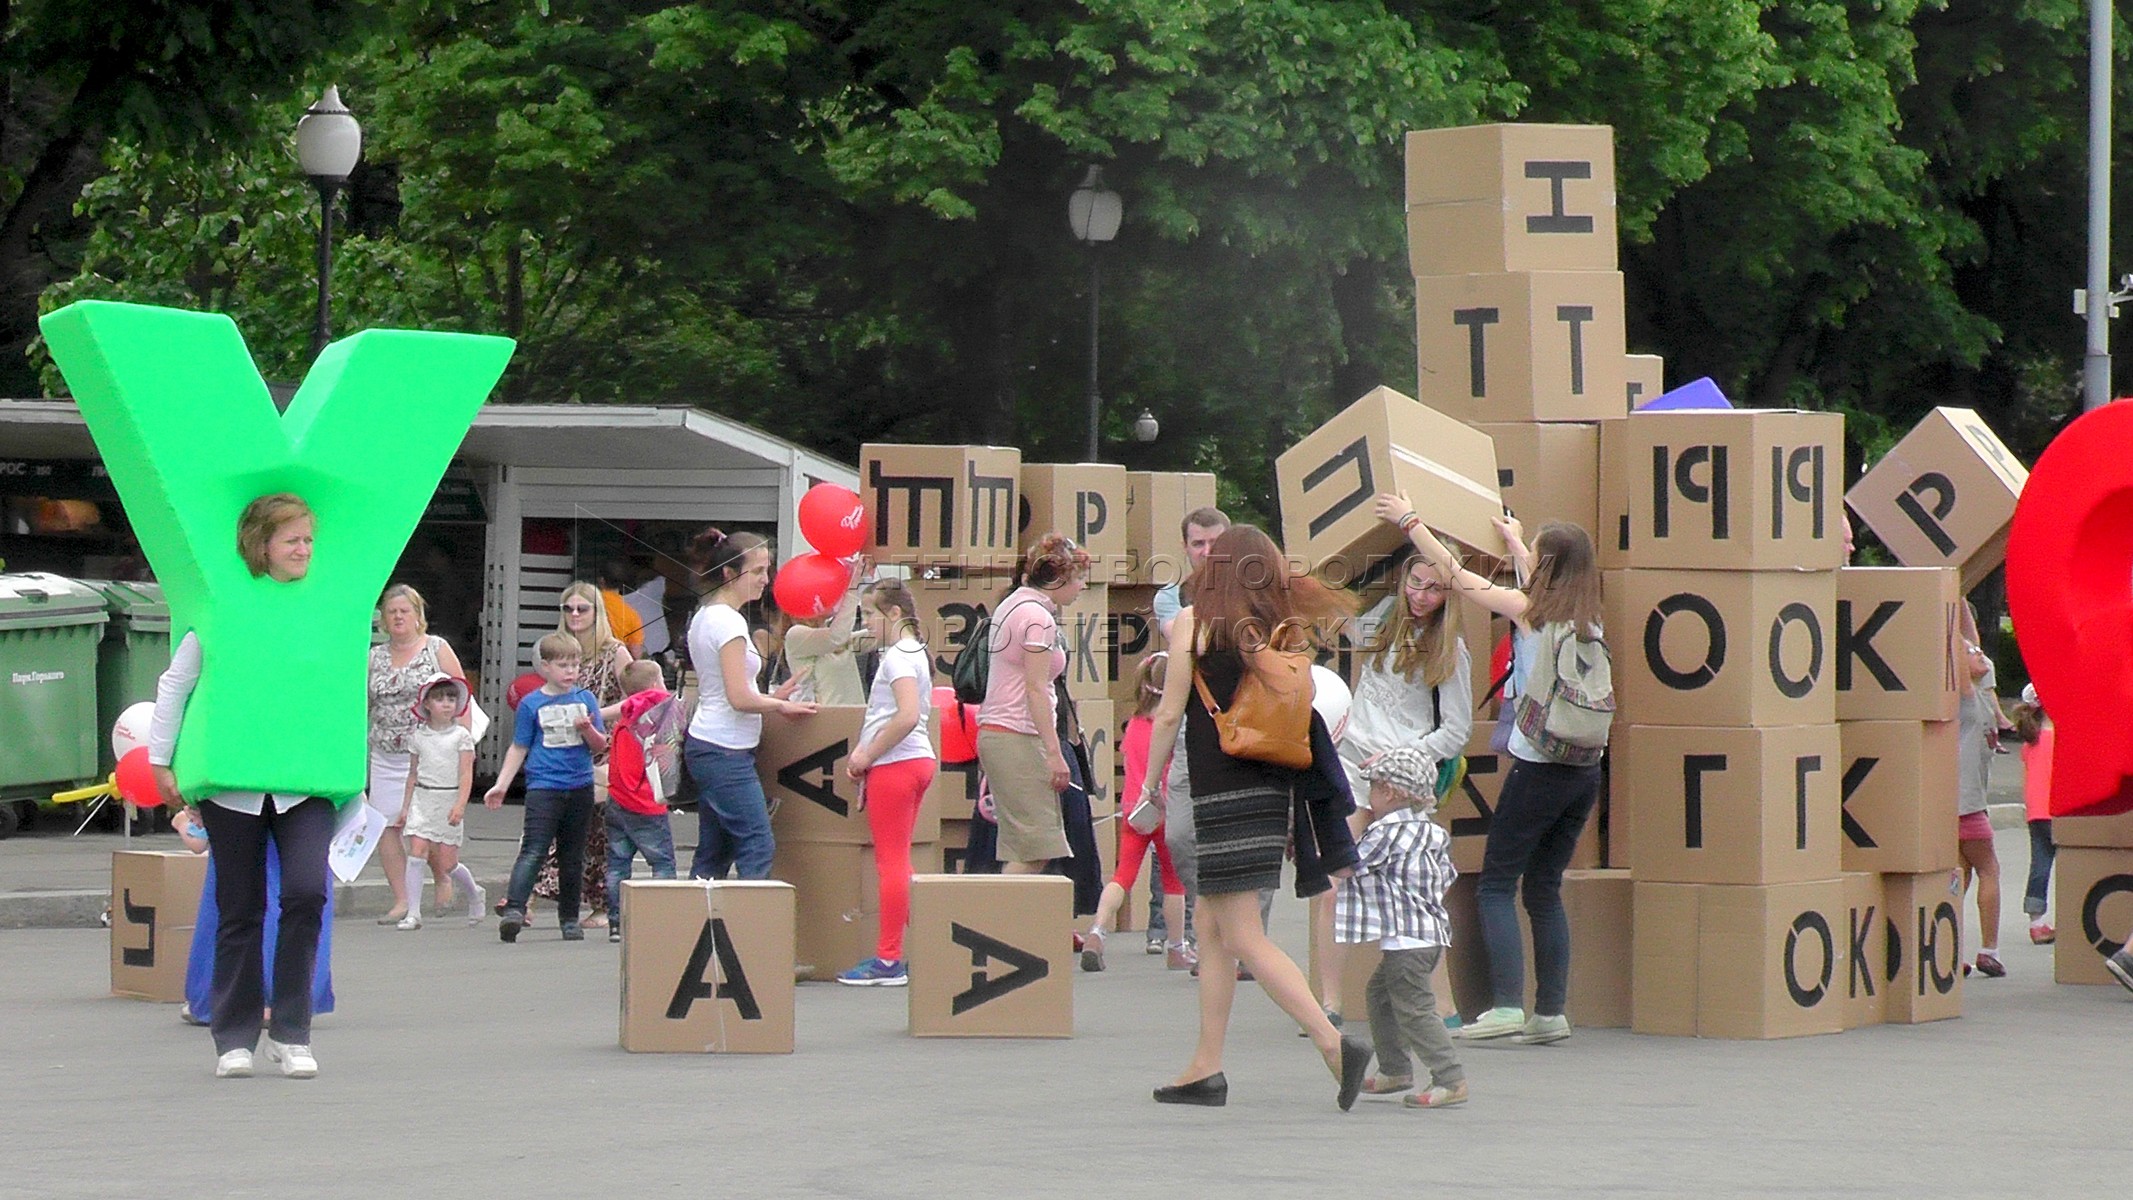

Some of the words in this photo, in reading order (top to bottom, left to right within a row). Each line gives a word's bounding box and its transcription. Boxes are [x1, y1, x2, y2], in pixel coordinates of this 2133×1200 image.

[1454, 307, 1499, 398] Т
[1556, 306, 1594, 395] Т
[1895, 471, 1958, 558] Р
[1077, 612, 1100, 682] К
[1643, 592, 1727, 690] О
[1768, 602, 1823, 698] О
[1836, 600, 1908, 691] К
[1683, 754, 1727, 849] Г
[1796, 755, 1821, 850] Г
[666, 918, 763, 1020] А
[1784, 910, 1834, 1008] О
[1849, 905, 1876, 999] К
[1918, 901, 1959, 996] Ю
